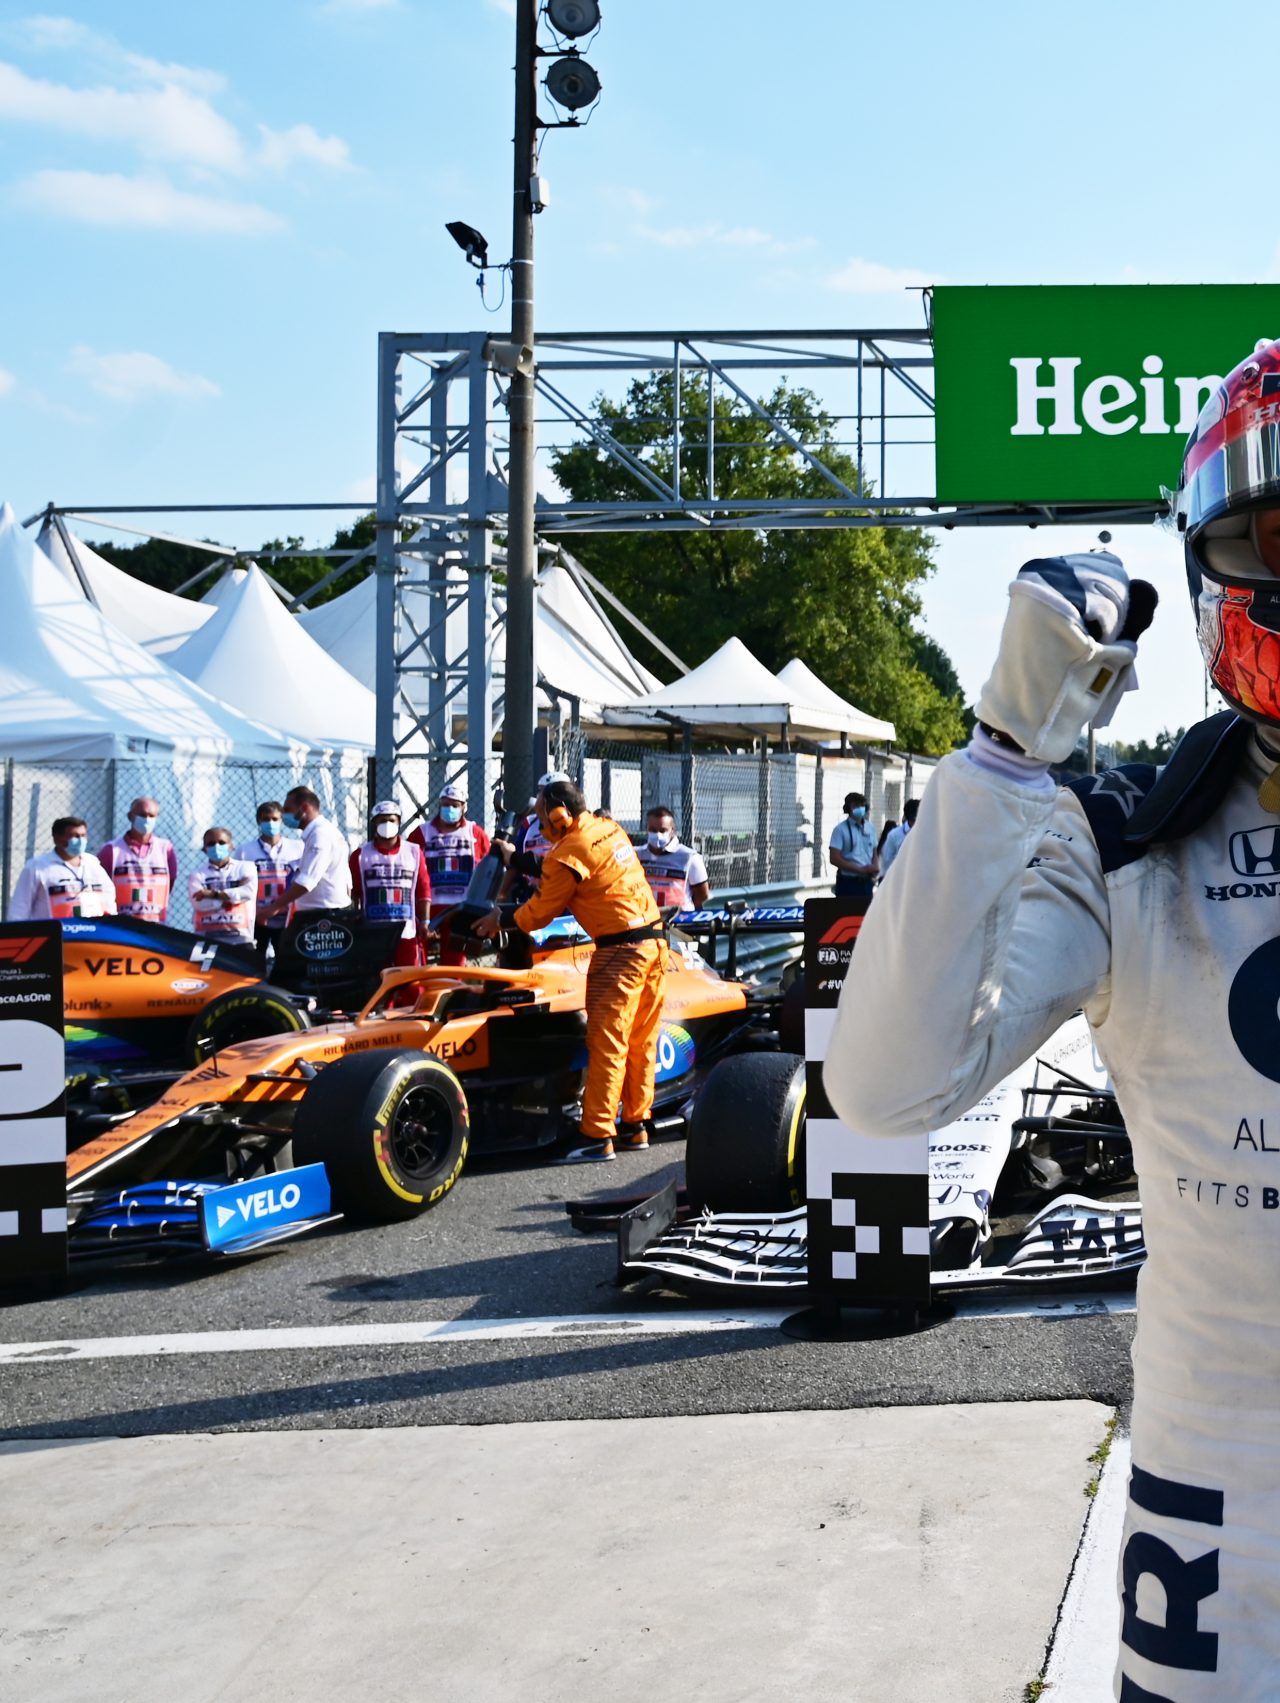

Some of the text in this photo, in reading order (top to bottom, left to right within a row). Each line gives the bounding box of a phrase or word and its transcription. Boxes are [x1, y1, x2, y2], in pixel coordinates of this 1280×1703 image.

[304, 931, 345, 942] Estrella
[305, 941, 343, 952] Galicia
[189, 941, 218, 973] 4
[818, 950, 837, 962] FIA
[85, 957, 165, 977] VELO
[323, 1033, 403, 1056] RICHARD MILLE
[429, 1039, 477, 1060] VELO
[236, 1183, 301, 1222] VELO
[1118, 1463, 1225, 1703] RI
